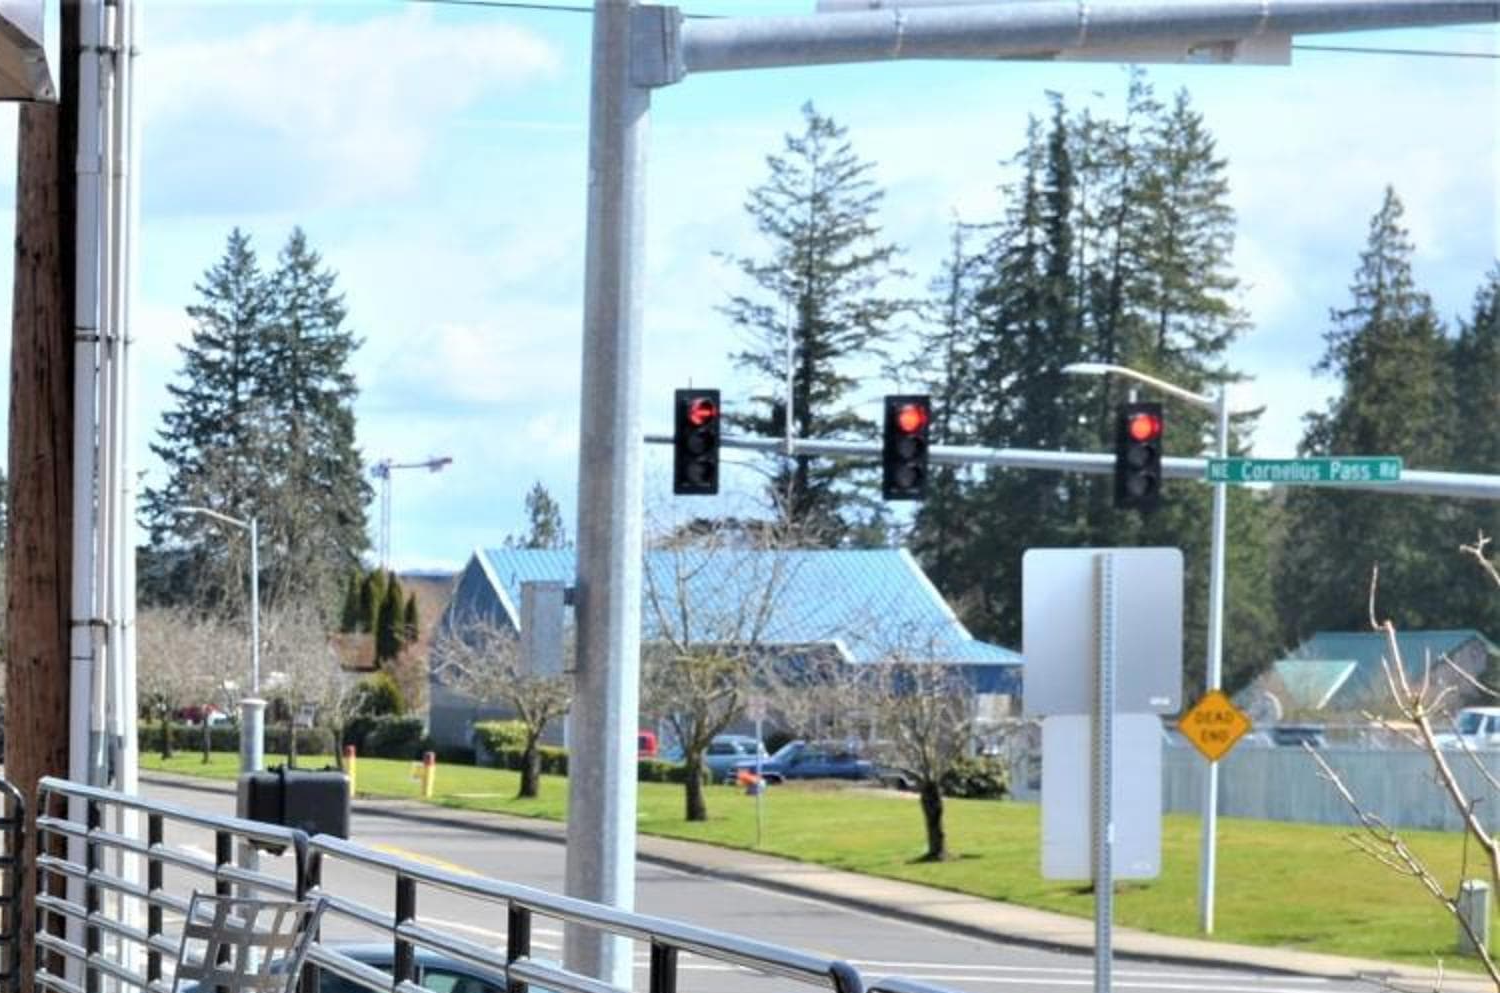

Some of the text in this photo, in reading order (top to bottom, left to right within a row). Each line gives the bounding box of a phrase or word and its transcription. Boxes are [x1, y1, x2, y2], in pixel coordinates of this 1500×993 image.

[1211, 462, 1397, 481] NE Cornelius Pass Rd
[1195, 710, 1235, 725] DEAD
